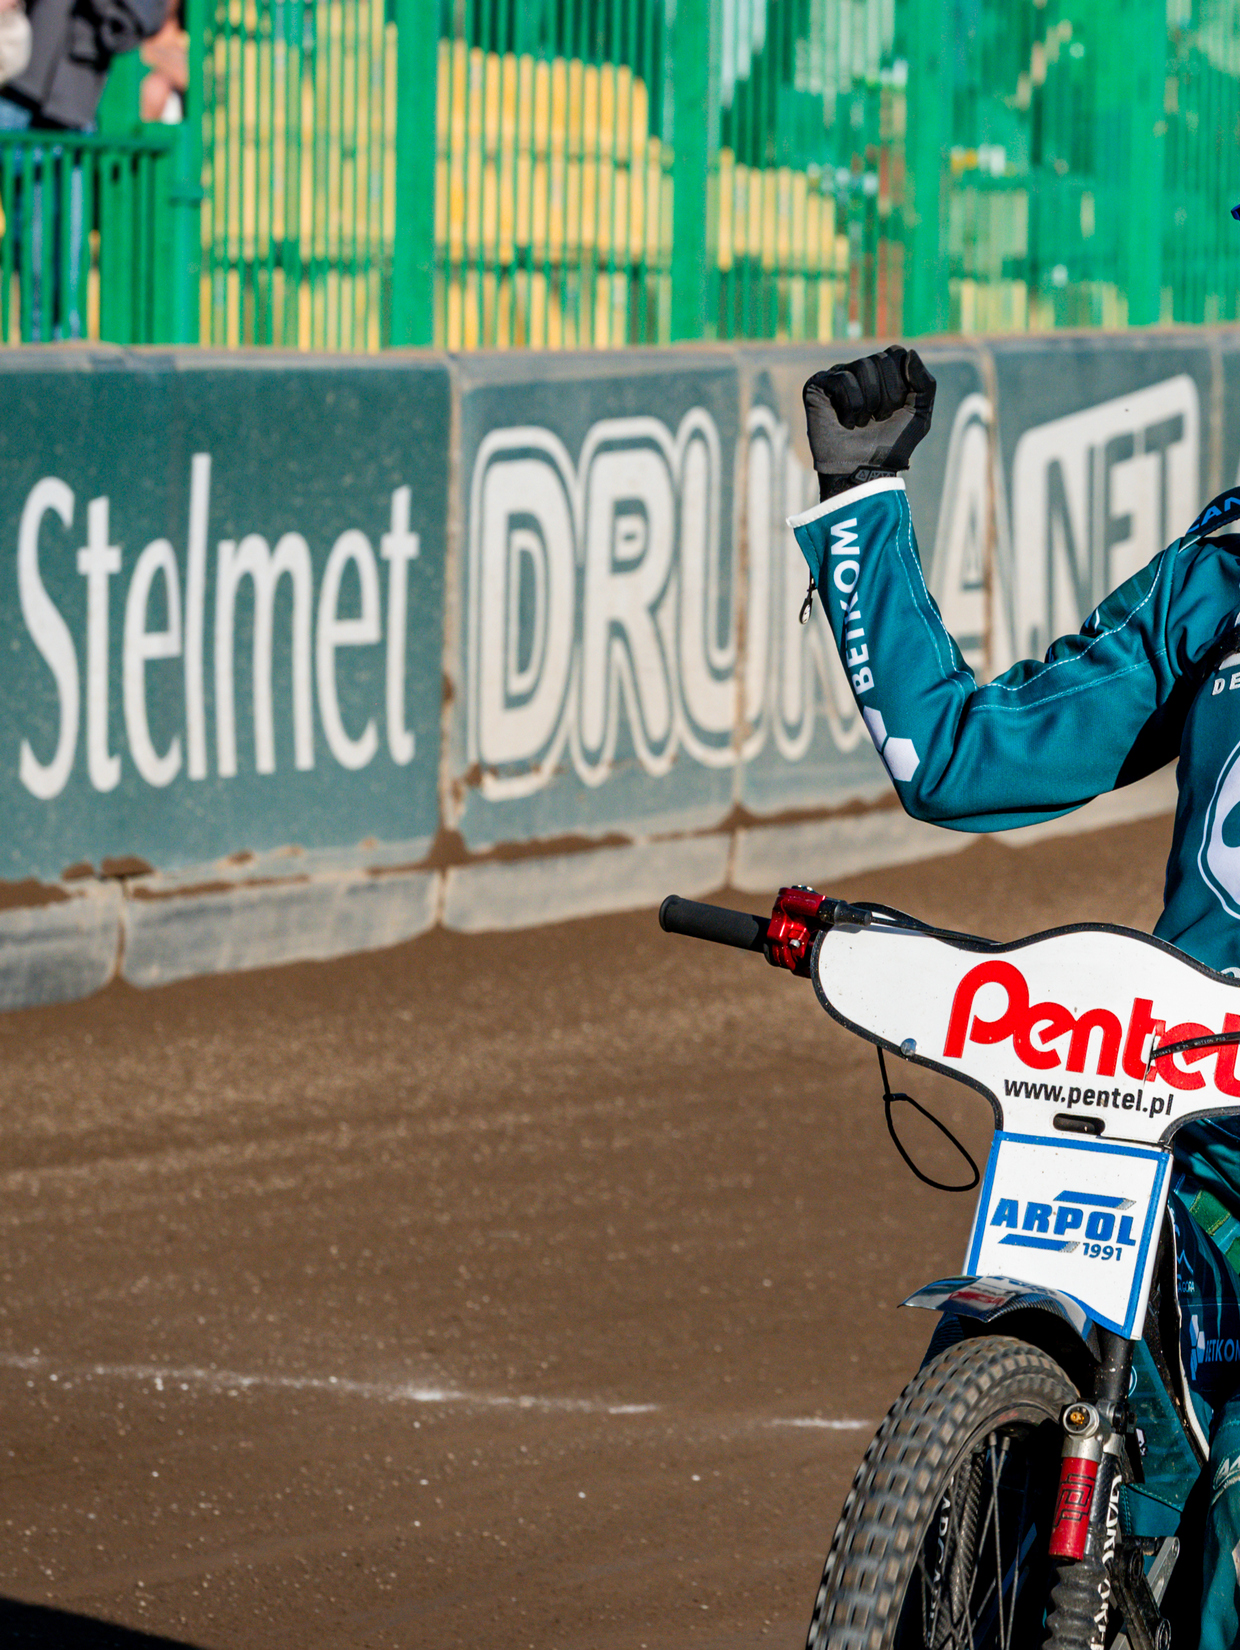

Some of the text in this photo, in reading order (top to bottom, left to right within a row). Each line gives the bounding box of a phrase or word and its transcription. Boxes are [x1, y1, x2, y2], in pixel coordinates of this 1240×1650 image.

[17, 452, 420, 800] Stelmet
[830, 517, 875, 695] BETKOM
[1004, 1079, 1175, 1119] www.pentel.pl
[989, 1197, 1137, 1247] ARPOL
[1082, 1242, 1123, 1262] 1991
